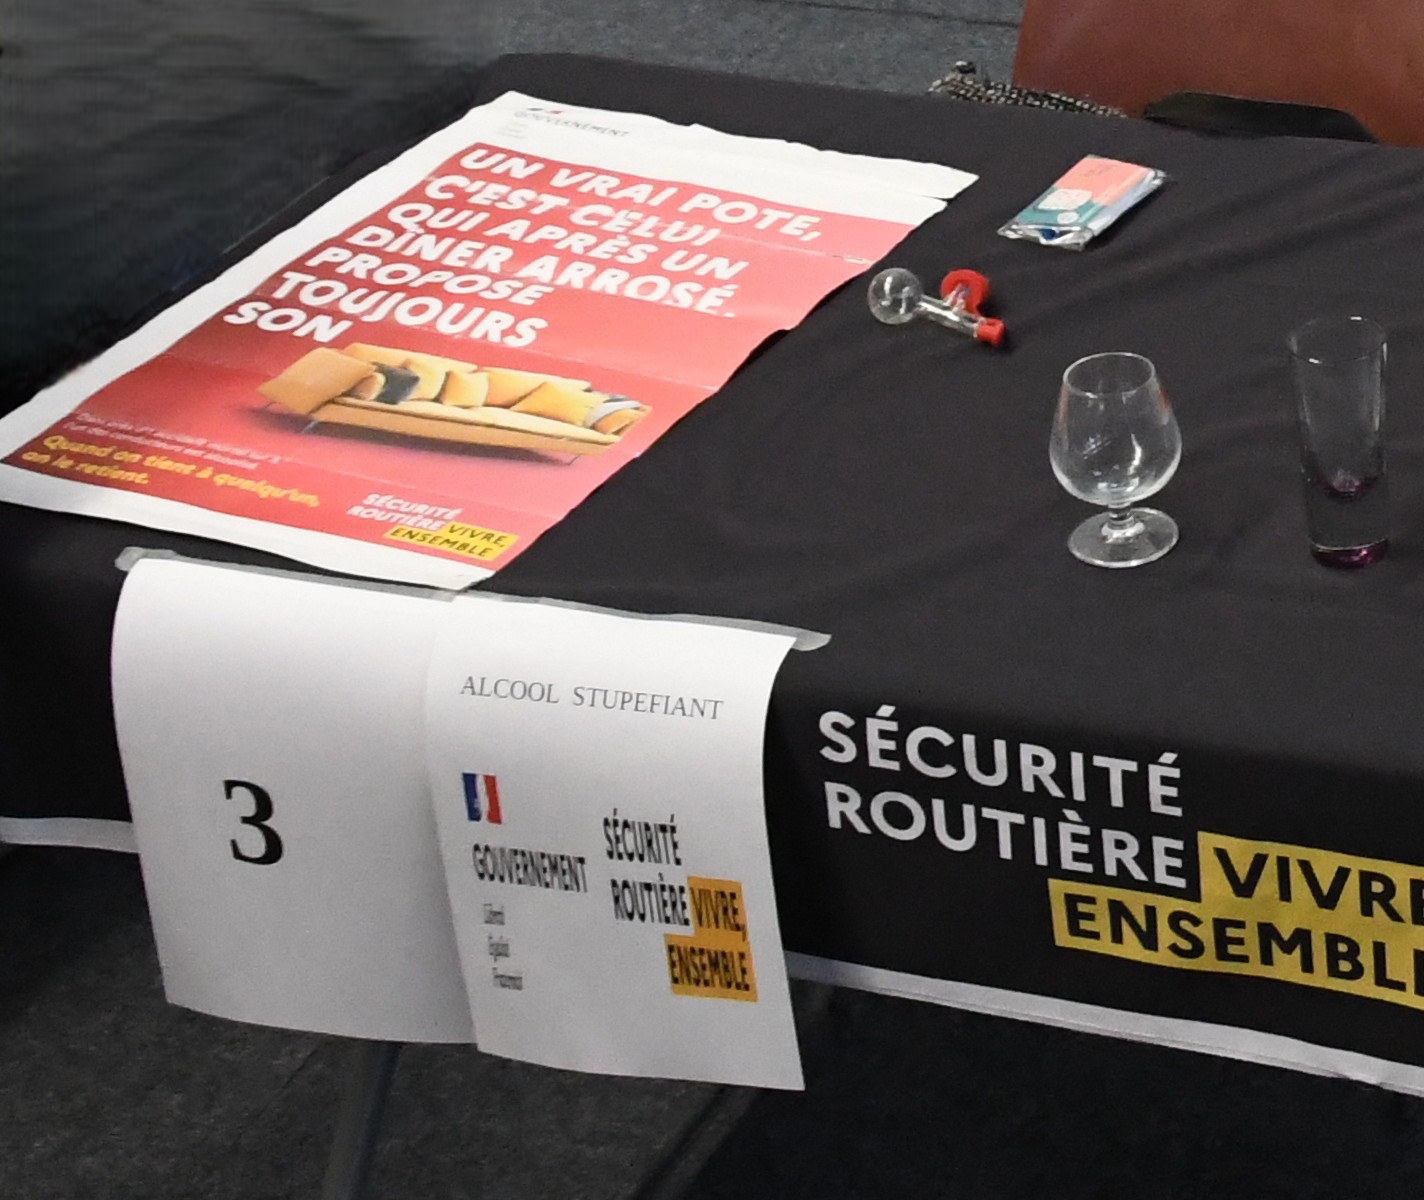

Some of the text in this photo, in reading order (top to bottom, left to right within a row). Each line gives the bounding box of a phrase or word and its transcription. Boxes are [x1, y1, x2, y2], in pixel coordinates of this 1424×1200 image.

[424, 174, 721, 246] C'EST CELUI
[459, 148, 822, 242] UN VRAI POTE,
[346, 224, 741, 318] DÎNER ARROSÉ.
[387, 202, 750, 280] QUI APRÈS UN
[304, 246, 556, 307] PROPOSE
[222, 300, 354, 343] SON
[271, 271, 549, 348] TOUJOURS
[21, 451, 150, 485] on le retient.
[43, 434, 114, 458] Quand
[113, 450, 143, 464] on
[143, 454, 197, 476] tient
[196, 465, 213, 479] à
[346, 505, 508, 548] ROUTIÈRE VIVRE,
[362, 492, 465, 521] SÉCURITÉ
[389, 527, 494, 558] ENSEMBLE
[459, 674, 725, 722] ALCOOL STUPEFIANT
[818, 704, 1184, 819] SÉCURITÉ
[222, 778, 285, 866] 3
[603, 806, 682, 867] SÉCURITÉ
[823, 780, 1189, 890] ROUTIÈRE
[472, 842, 588, 893] GOUVERNEMENT
[610, 871, 747, 942] ROUTIÈRE VIVRE,
[666, 943, 751, 992] ENSEMBLE
